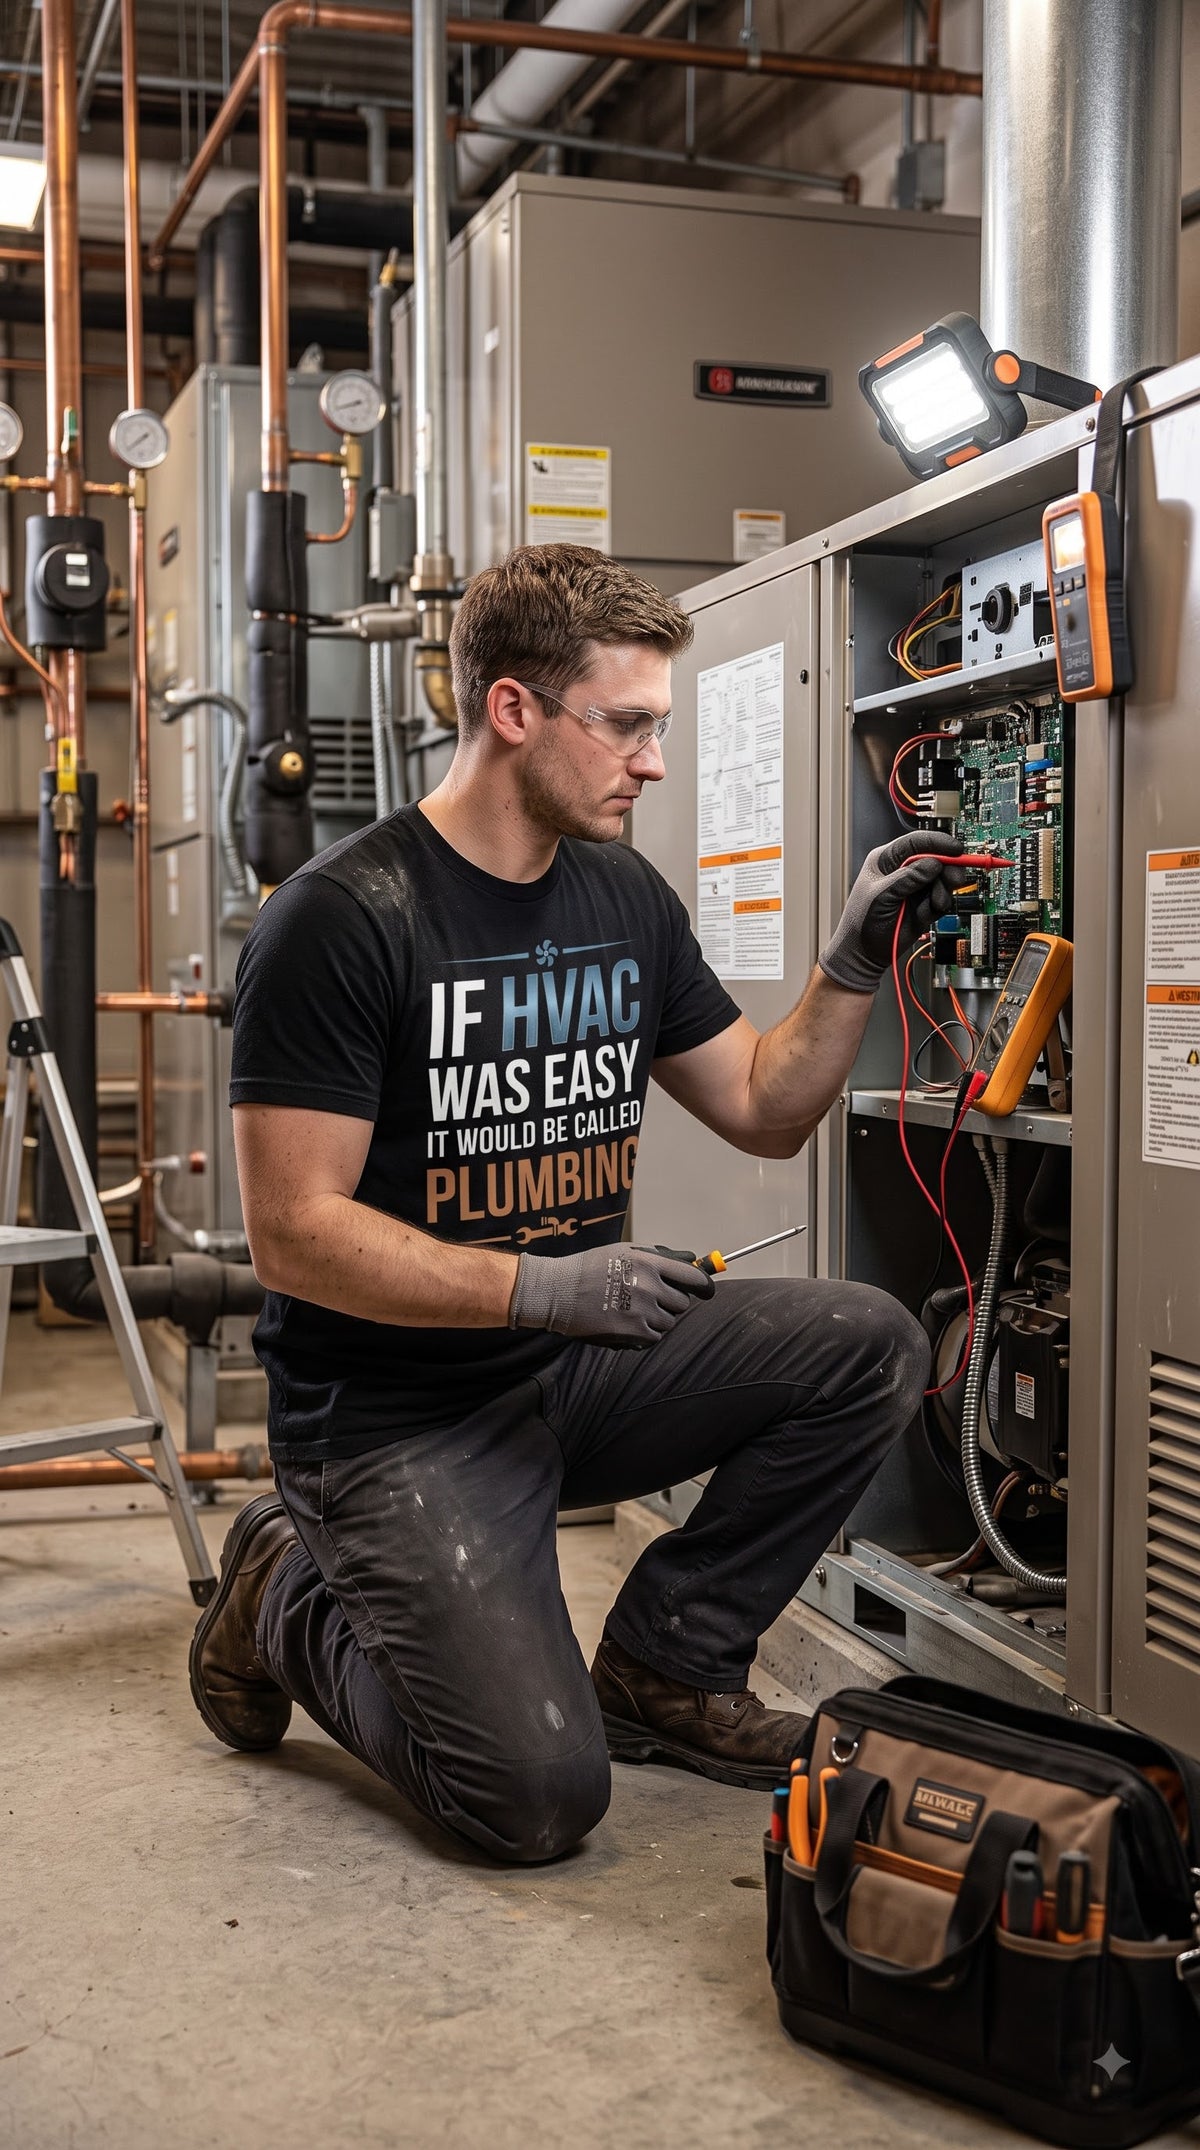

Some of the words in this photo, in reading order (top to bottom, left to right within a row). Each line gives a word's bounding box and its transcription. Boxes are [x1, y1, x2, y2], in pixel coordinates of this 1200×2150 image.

[429, 979, 486, 1060] IF
[501, 958, 641, 1052] HVAC
[428, 1058, 531, 1122] WAS
[544, 1038, 640, 1109] EASY
[427, 1130, 450, 1158] IT
[457, 1121, 536, 1157] WOULD
[543, 1115, 569, 1145] BE
[574, 1099, 641, 1139] CALLED
[426, 1135, 640, 1224] PLUMBING
